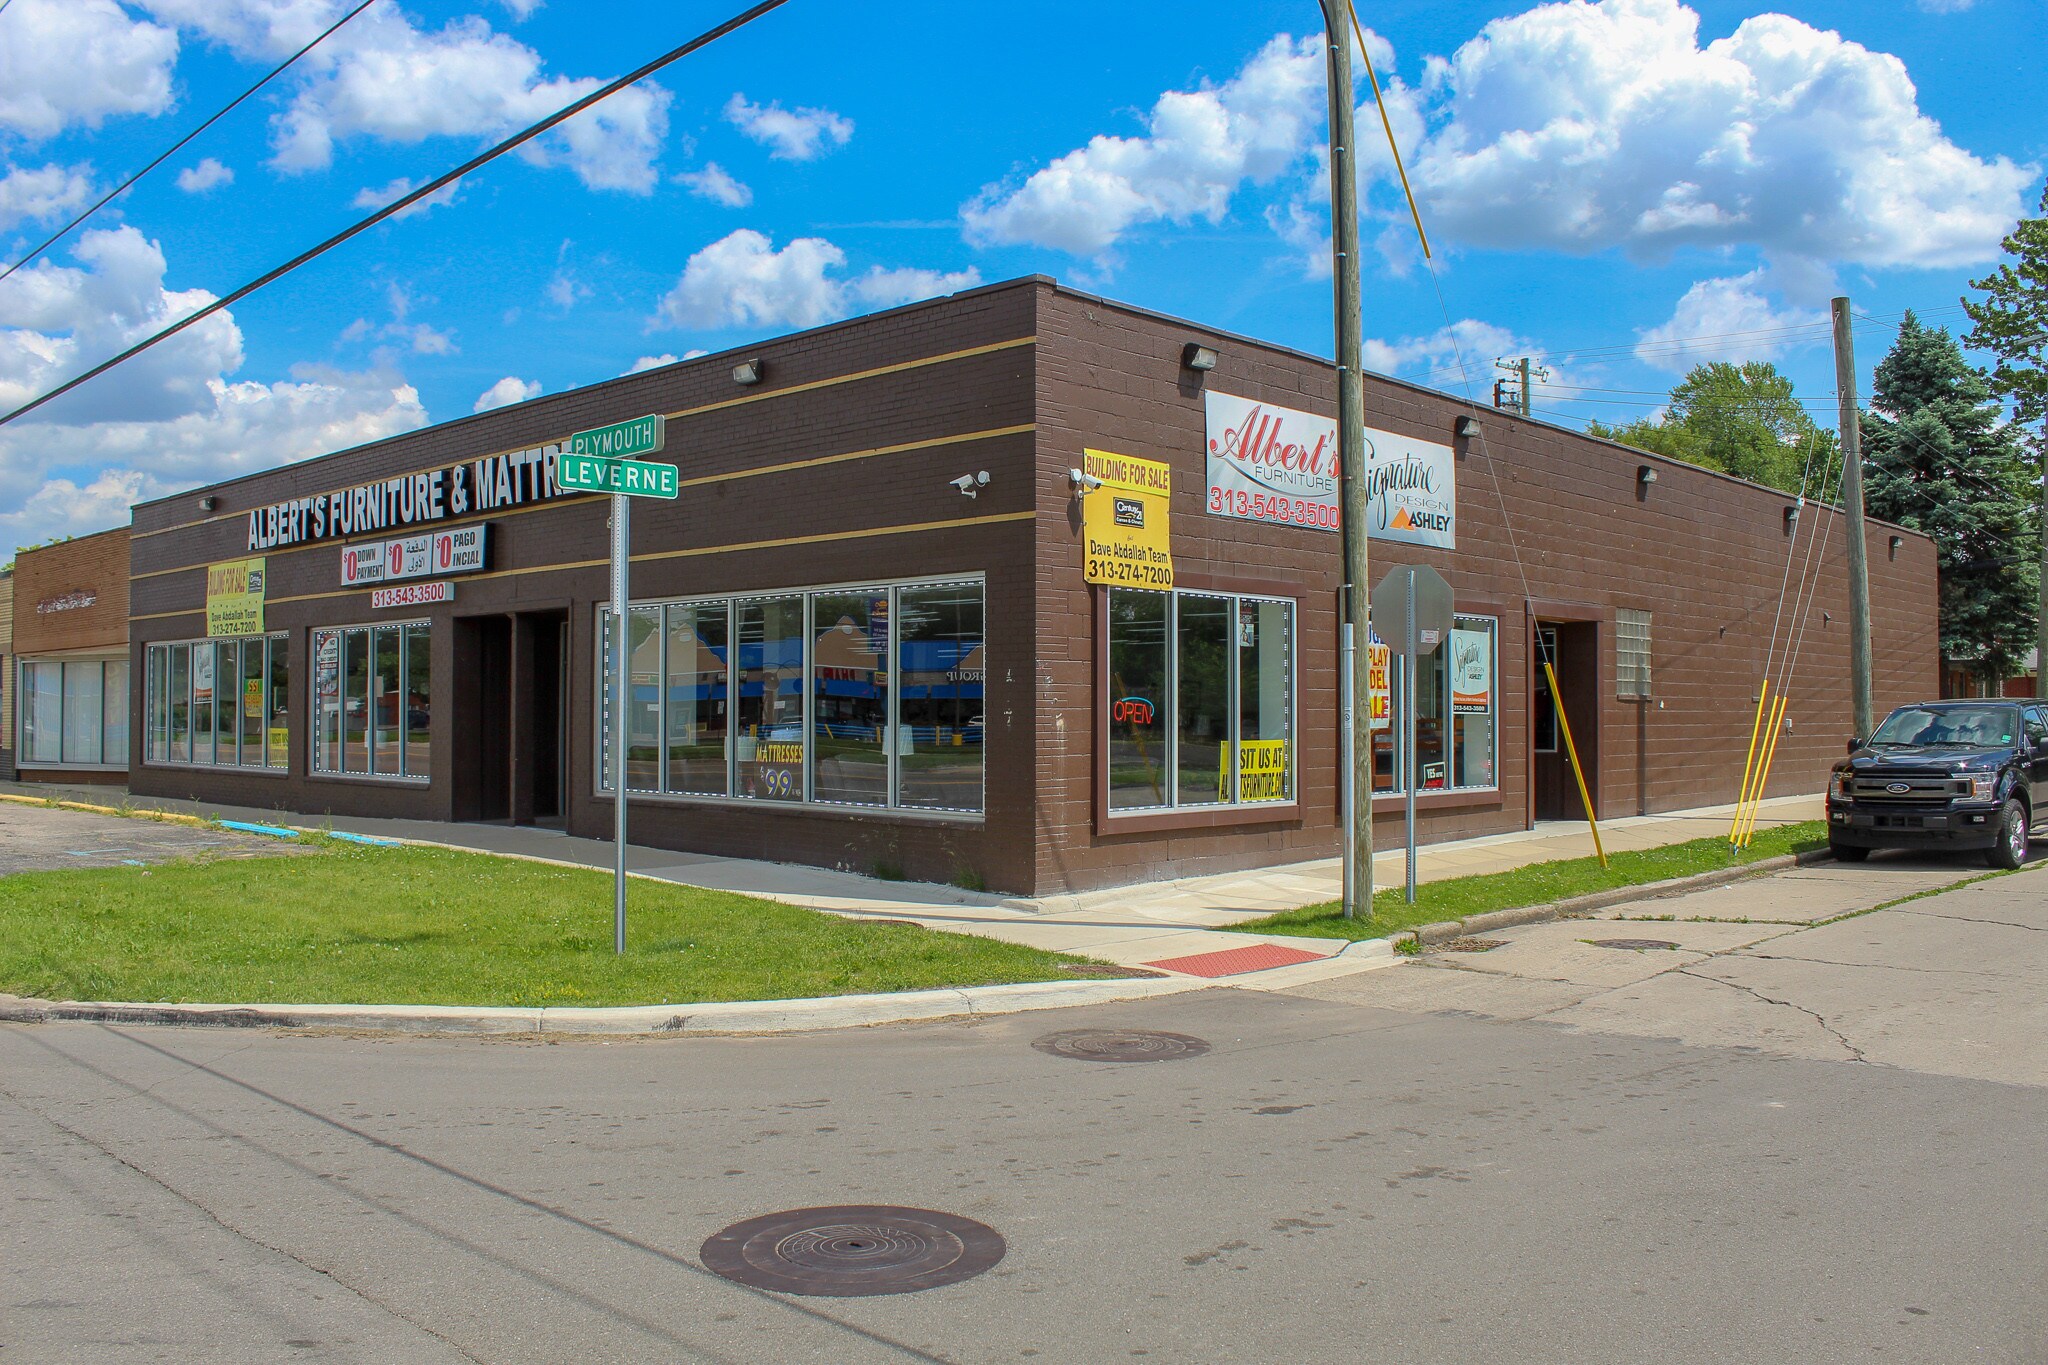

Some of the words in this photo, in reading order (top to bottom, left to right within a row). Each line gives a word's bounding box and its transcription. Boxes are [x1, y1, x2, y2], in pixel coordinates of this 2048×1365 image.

[575, 422, 651, 455] PLYMOUTH
[1209, 405, 1339, 479] Albert's
[565, 460, 672, 492] LEVERNE
[1086, 455, 1127, 483] BUILDING
[1129, 463, 1145, 486] FOR
[1148, 467, 1168, 490] SALE
[1255, 466, 1332, 491] FURNITURE
[248, 495, 326, 551] ALBERT'S
[330, 470, 443, 537] FURNITURE
[451, 465, 468, 514] &
[476, 440, 578, 510] MATTR
[1364, 438, 1440, 531] ignature
[1116, 501, 1138, 514] Century
[1209, 486, 1340, 529] 313-543-3500
[1395, 493, 1448, 512] DESIGN
[1409, 511, 1450, 532] ASHLEY
[406, 539, 428, 553] الدفعة
[453, 531, 475, 547] PAGO
[357, 548, 376, 562] DOWN
[453, 550, 479, 567] INCIAL
[1090, 540, 1111, 556] Dave
[1114, 543, 1146, 561] Abdallah
[1148, 547, 1168, 564] Team
[357, 564, 383, 580] PAYMENT
[1088, 560, 1171, 585] 313-274-7200
[374, 583, 444, 607] 313-543-3500
[244, 609, 257, 619] Team
[212, 621, 256, 635] 313-274-7200
[1368, 647, 1388, 666] PLAY
[1369, 669, 1388, 689] DEL
[1113, 701, 1152, 724] OPEN
[1371, 695, 1389, 718] LE
[756, 743, 803, 763] MATTRESSES
[1240, 748, 1256, 769] SIT
[1259, 747, 1270, 769] US
[1272, 747, 1282, 768] AT
